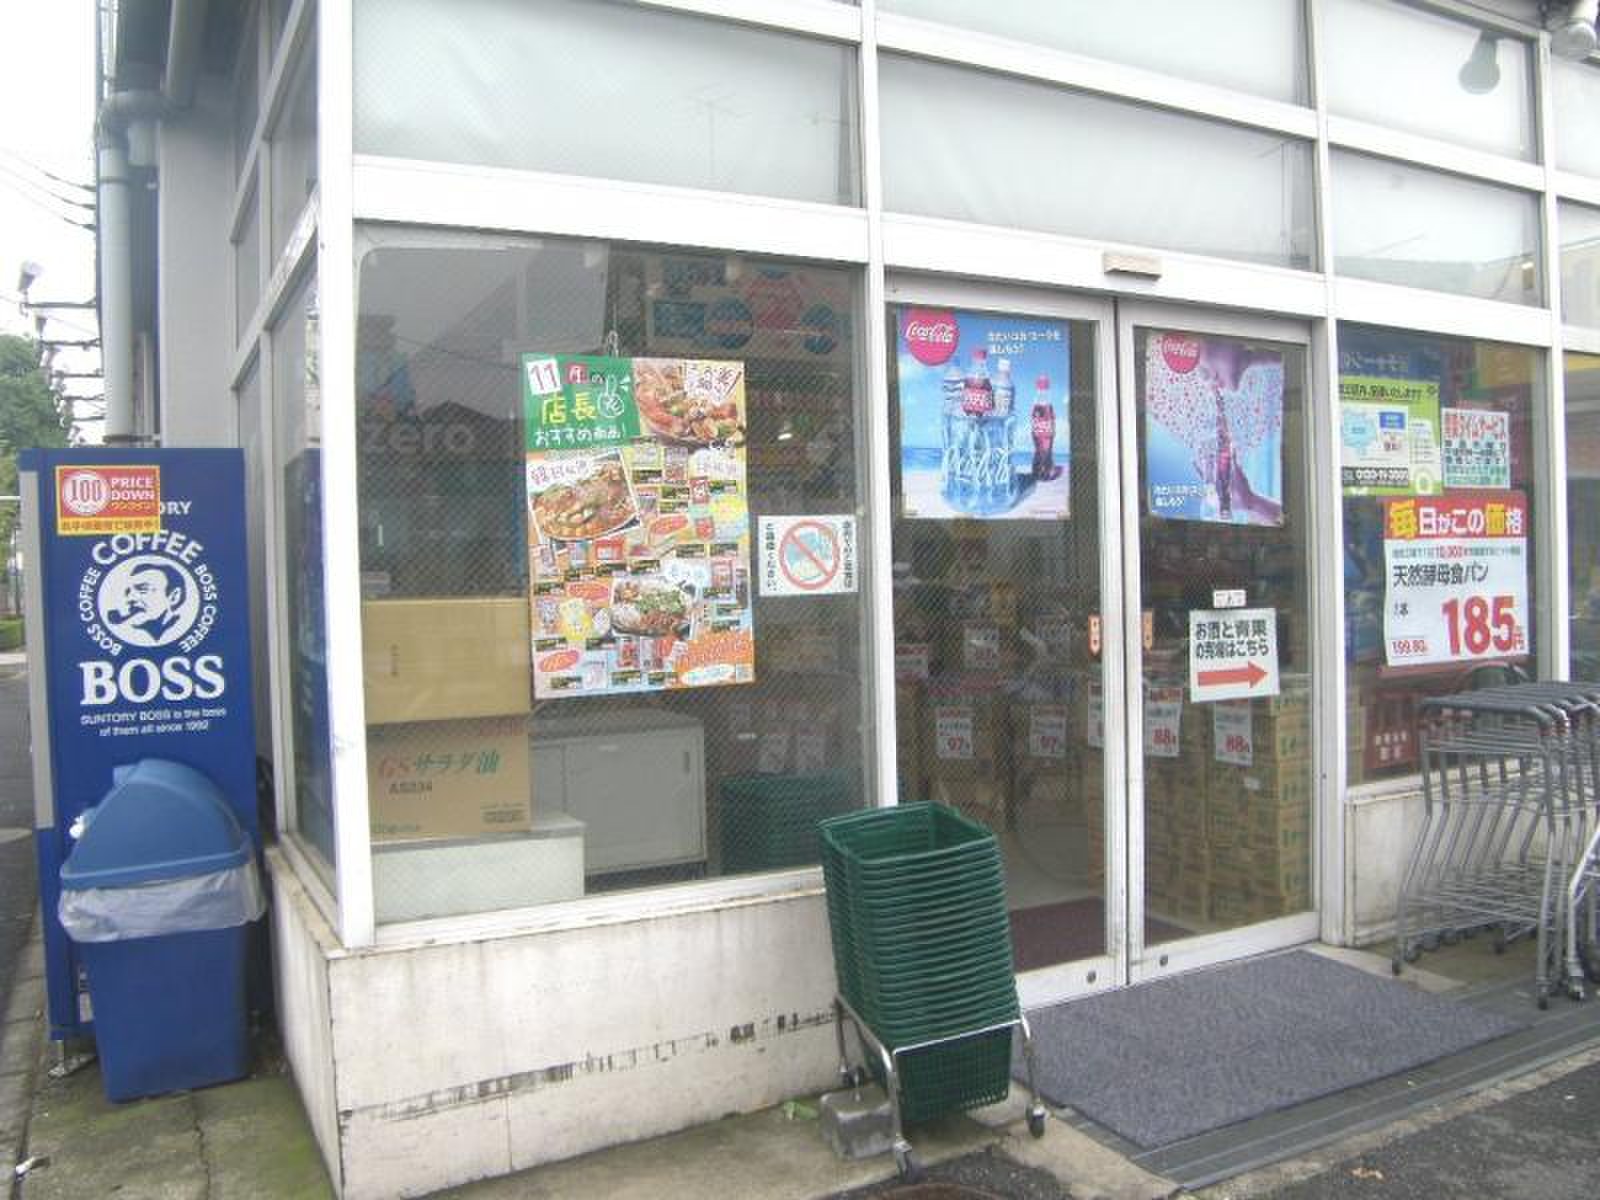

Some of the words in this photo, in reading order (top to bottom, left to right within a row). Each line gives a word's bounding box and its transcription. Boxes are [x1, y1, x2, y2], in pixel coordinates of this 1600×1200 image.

[111, 477, 153, 489] PRICE
[111, 489, 155, 501] DOWN
[92, 529, 203, 564] COFFEE
[80, 655, 225, 705] BOSS
